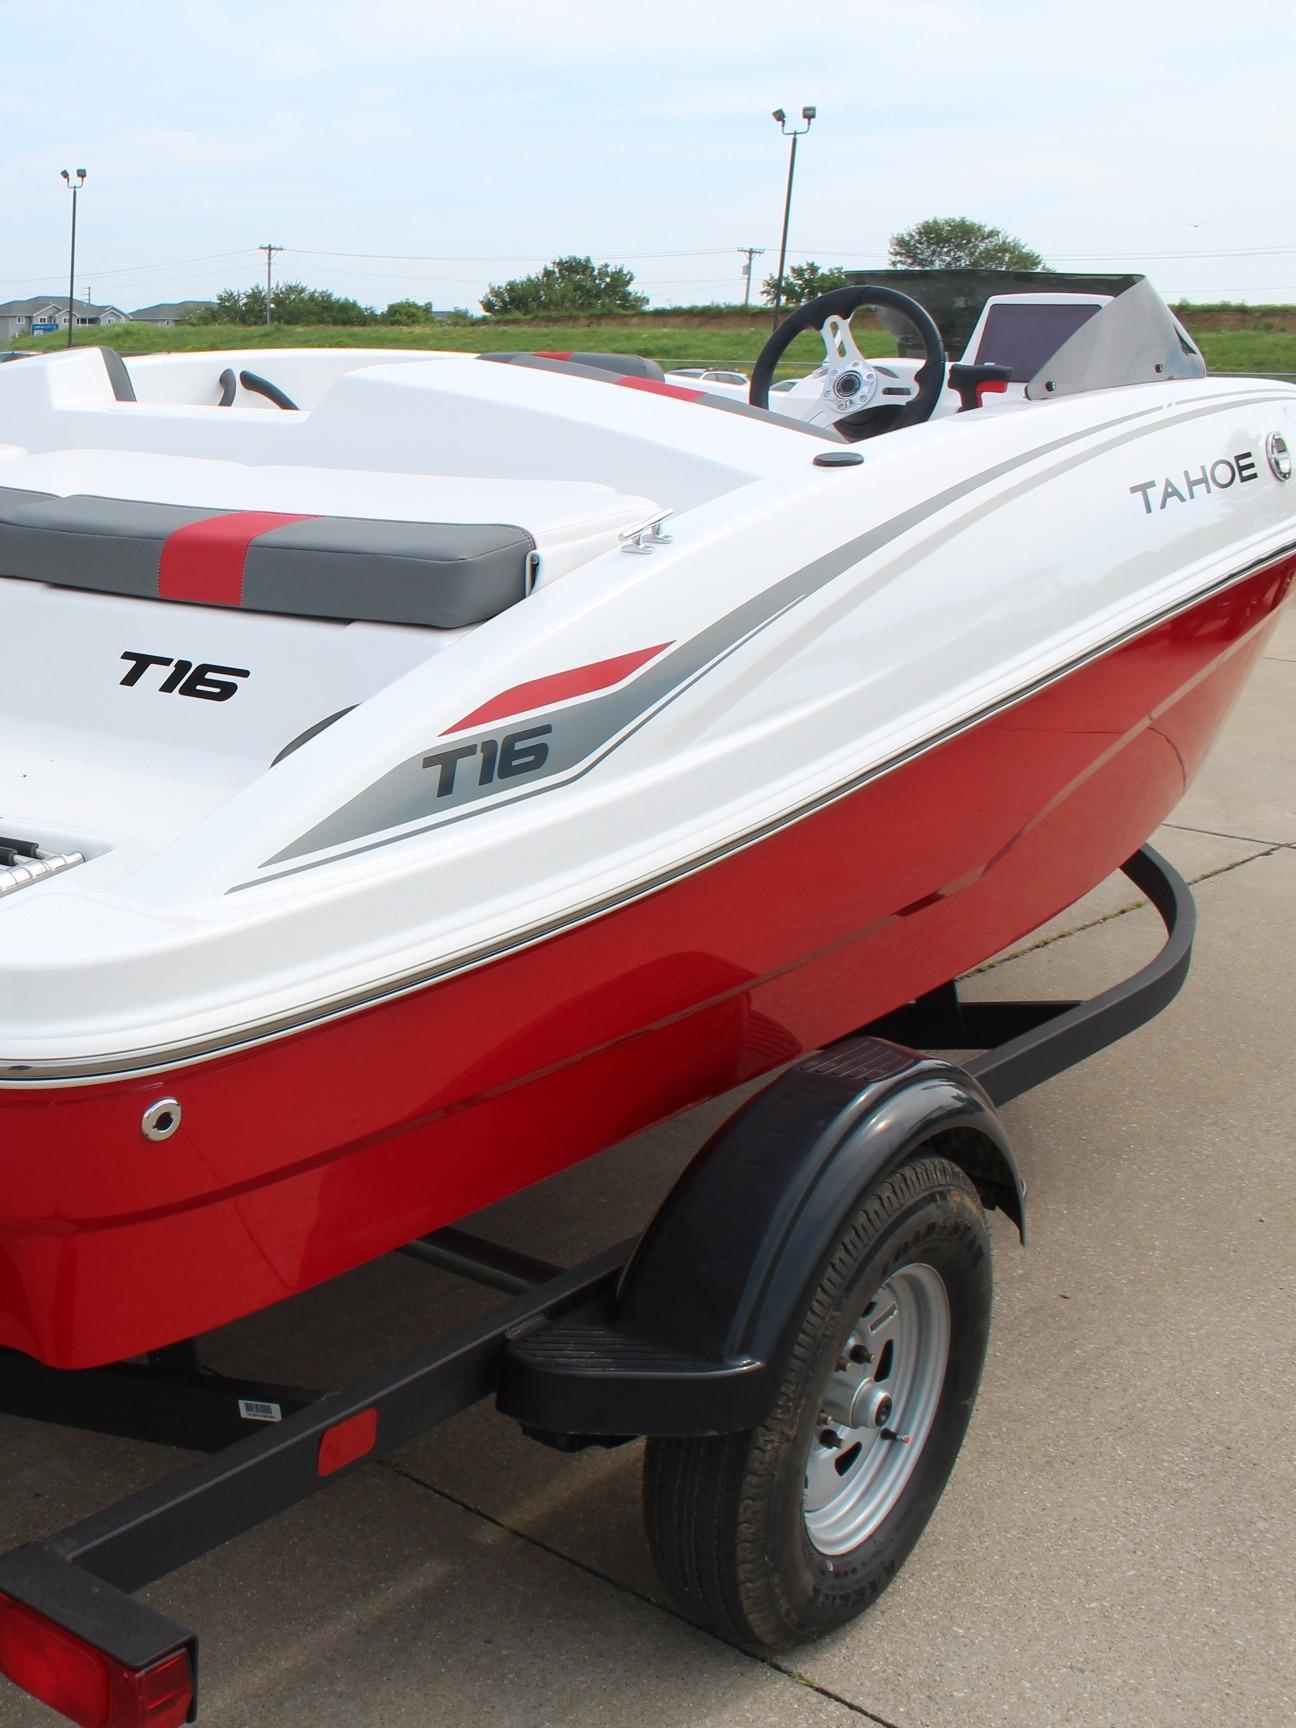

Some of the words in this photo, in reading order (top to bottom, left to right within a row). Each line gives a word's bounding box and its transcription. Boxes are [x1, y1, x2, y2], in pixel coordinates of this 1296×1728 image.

[1129, 451, 1258, 515] TAHOE
[119, 651, 251, 703] T16
[421, 724, 553, 798] T16
